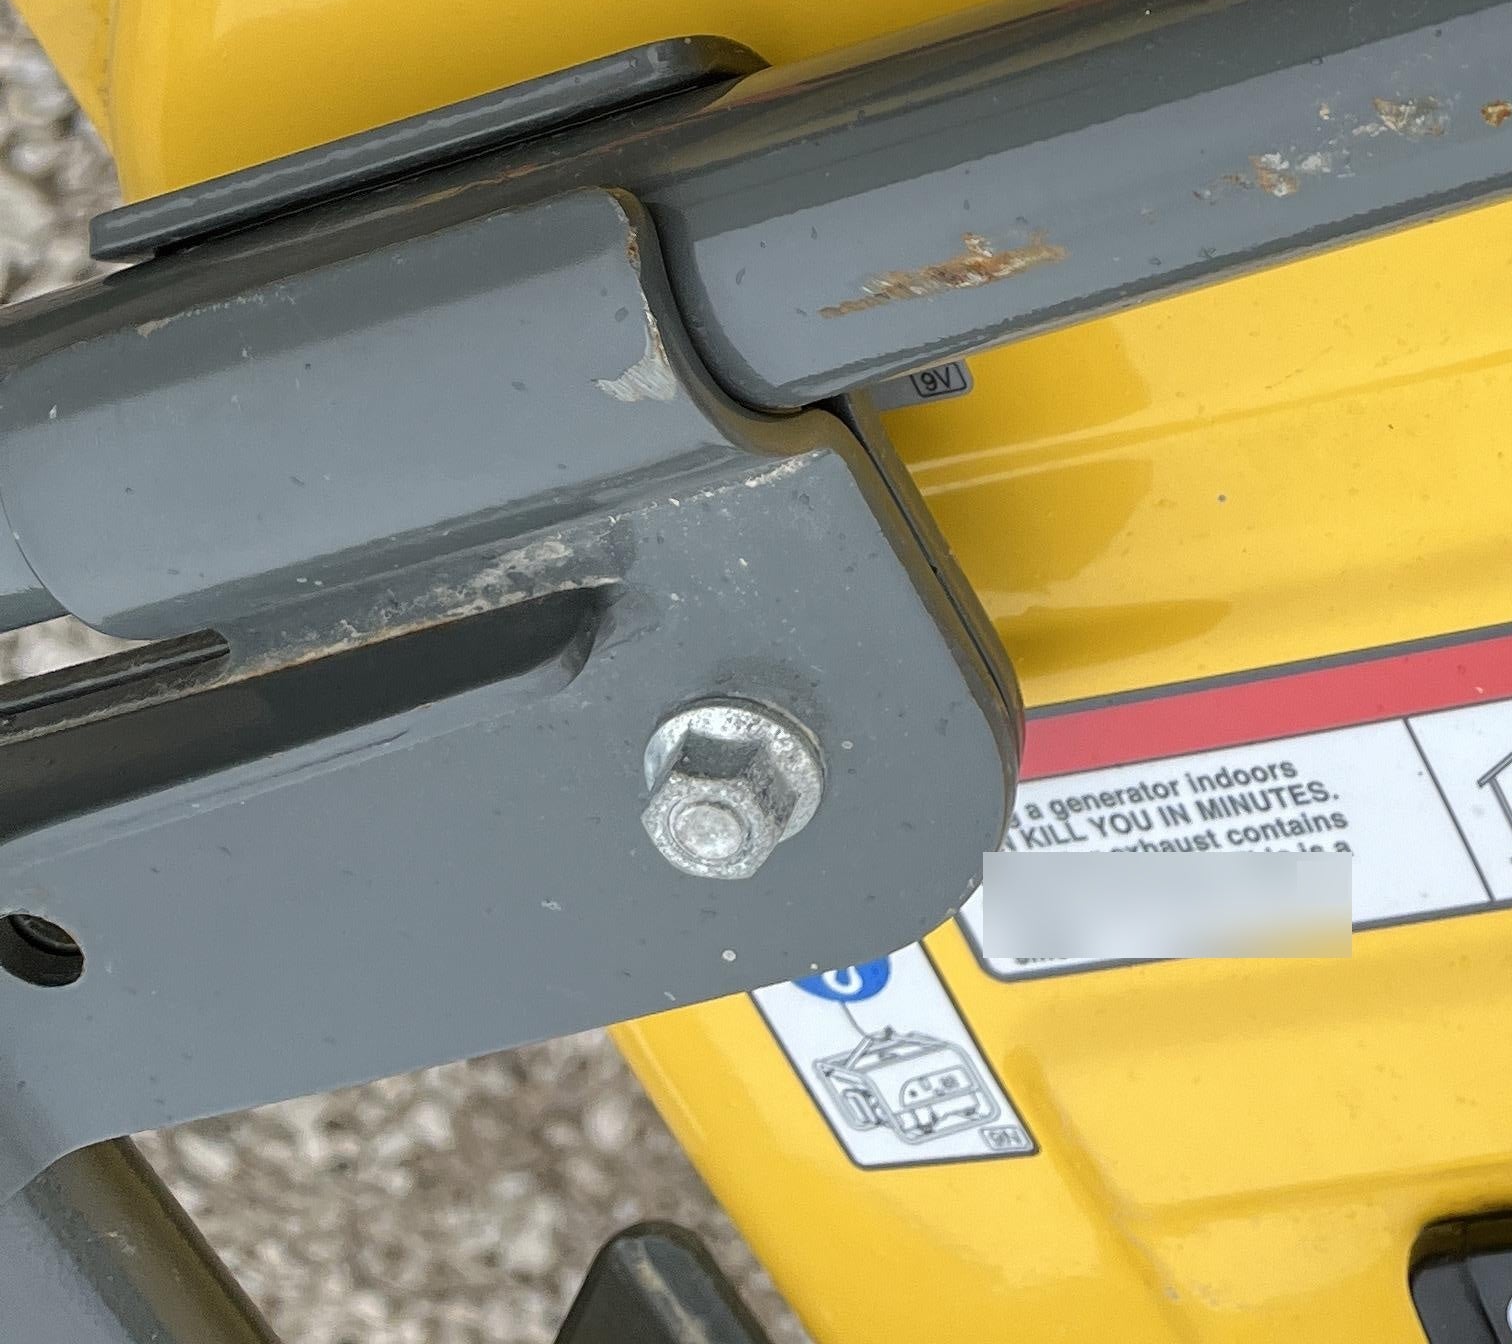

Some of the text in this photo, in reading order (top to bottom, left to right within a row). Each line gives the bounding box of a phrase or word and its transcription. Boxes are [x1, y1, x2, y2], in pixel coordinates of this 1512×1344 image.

[920, 366, 951, 392] 9V
[1018, 821, 1089, 850] KILL
[1086, 807, 1155, 839] YOU
[1156, 801, 1193, 828] IN
[1194, 779, 1341, 822] MINUTES.
[1023, 800, 1044, 821] a
[1048, 779, 1181, 822] generator
[1184, 760, 1299, 794] indoors
[1225, 811, 1349, 846] contains
